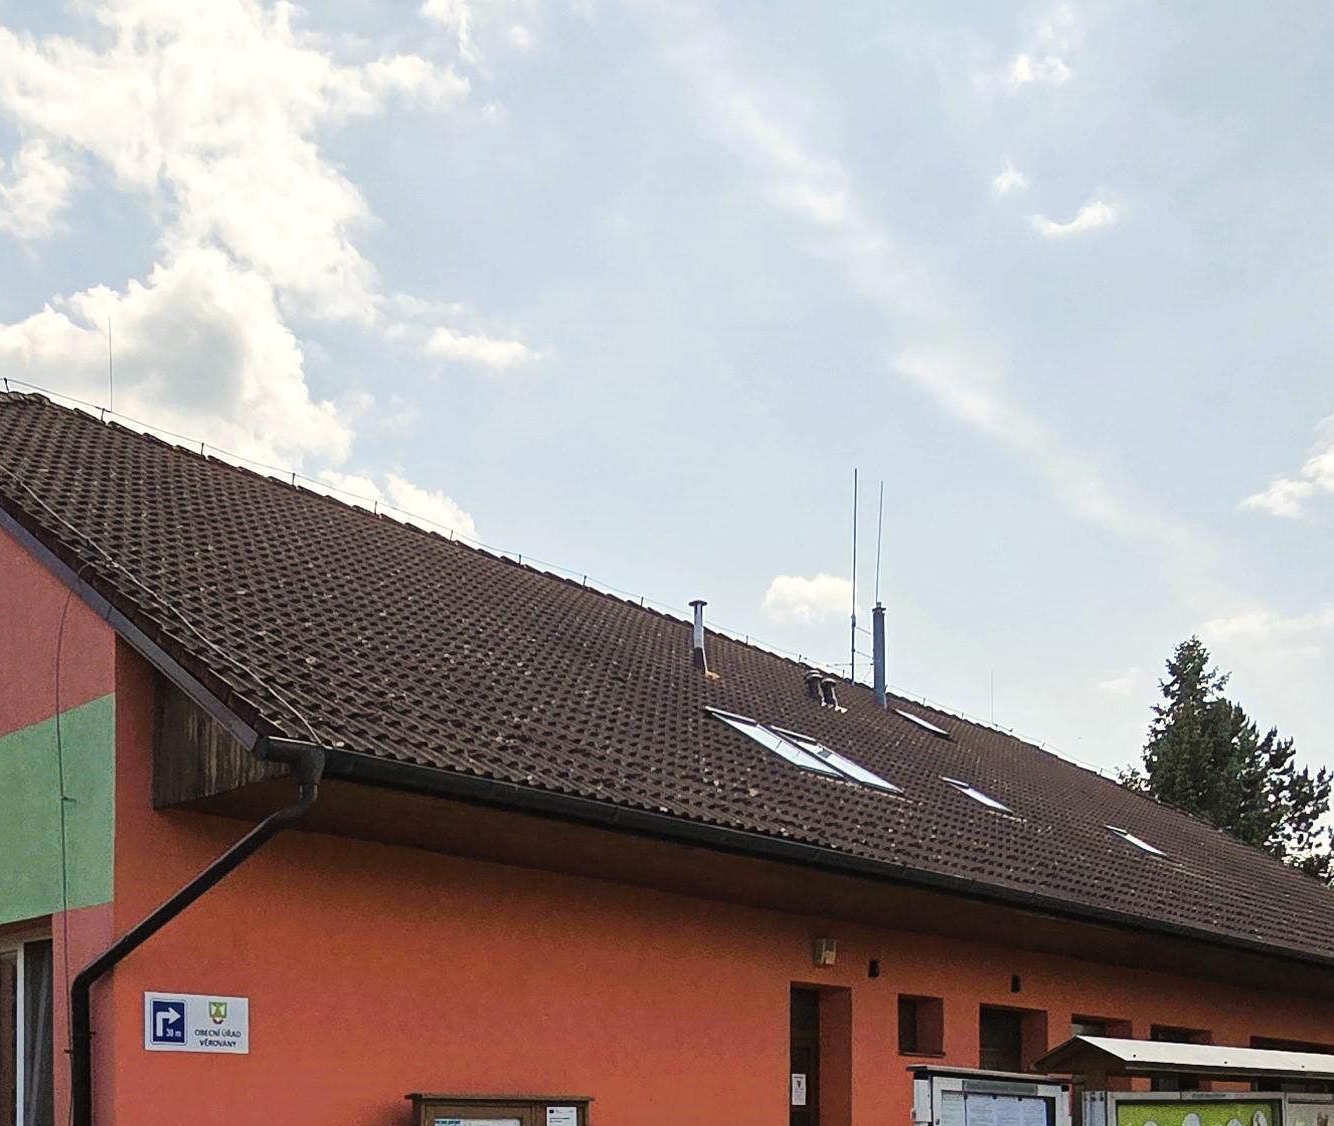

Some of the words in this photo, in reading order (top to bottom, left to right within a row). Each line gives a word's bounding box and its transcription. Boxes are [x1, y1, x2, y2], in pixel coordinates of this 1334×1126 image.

[194, 1028, 220, 1037] OBECNÍ
[221, 1028, 242, 1038] ÚŘAD
[199, 1038, 237, 1048] VĚROVANY
